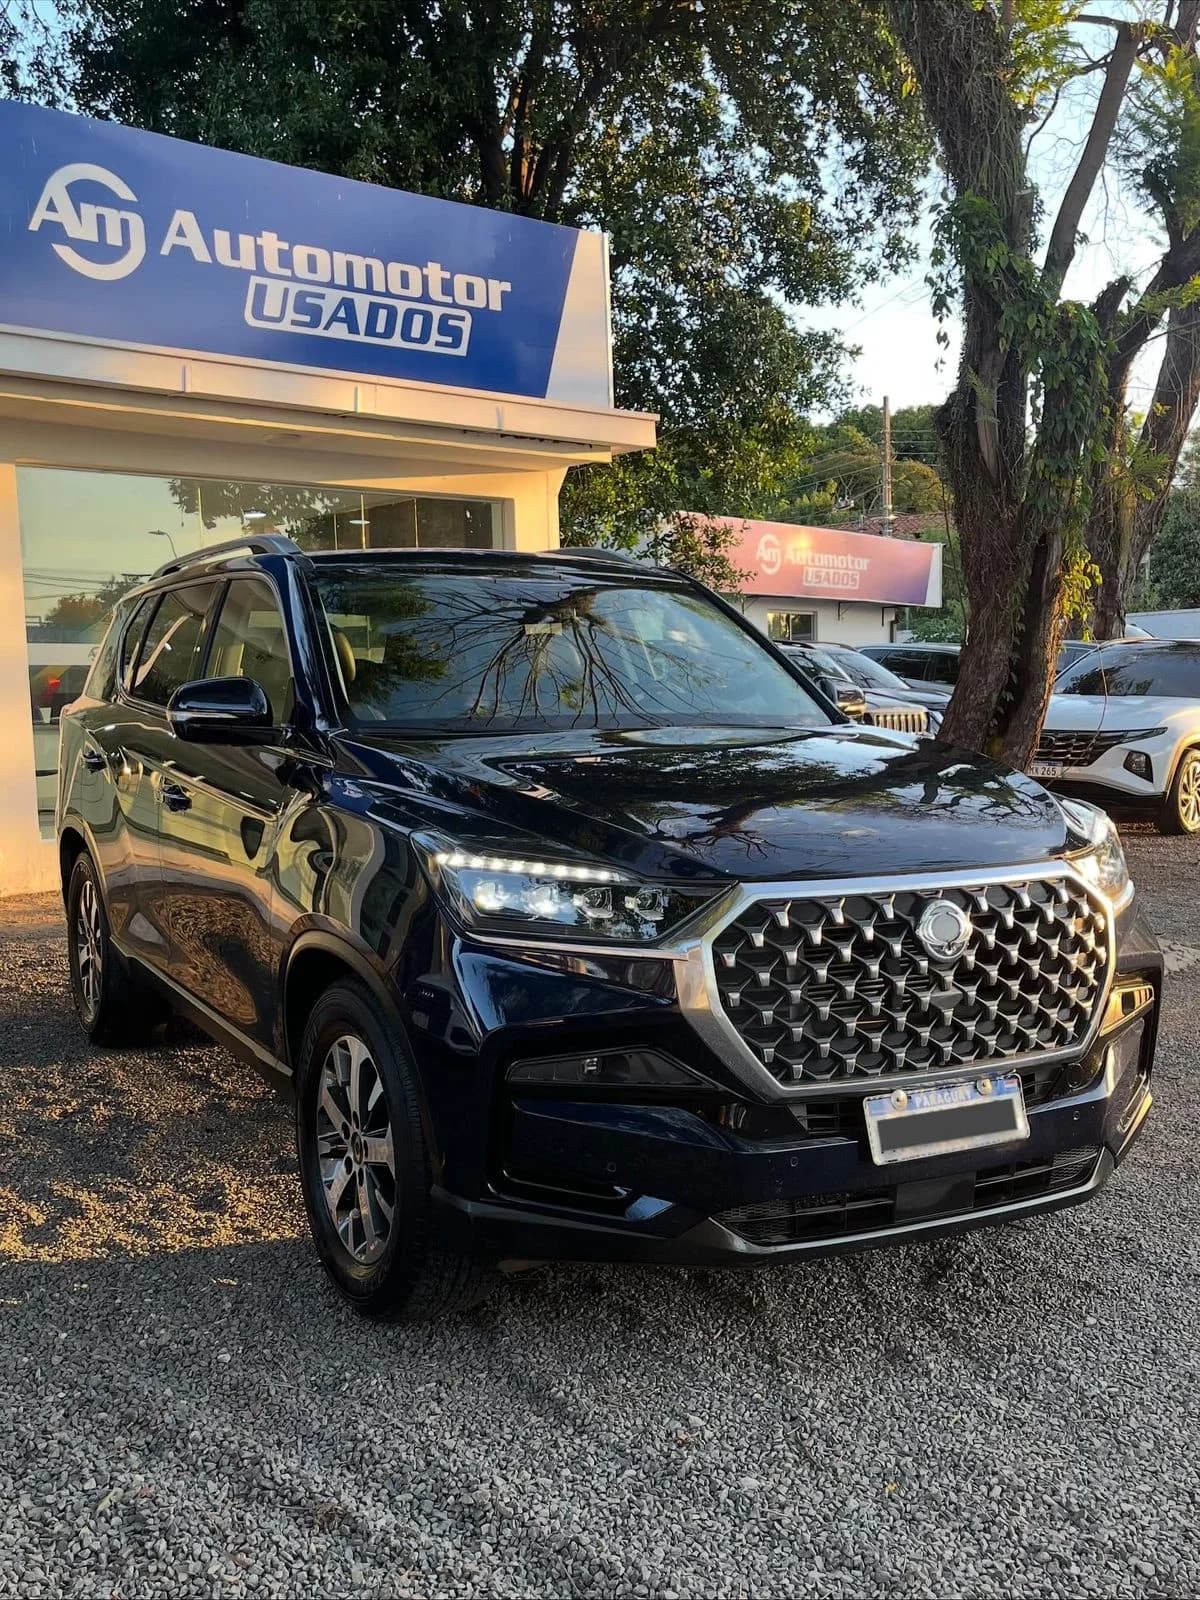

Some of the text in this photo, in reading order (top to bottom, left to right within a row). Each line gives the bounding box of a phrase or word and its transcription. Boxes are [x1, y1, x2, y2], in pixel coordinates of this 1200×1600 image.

[160, 208, 512, 312] Automotor
[249, 282, 467, 350] USADOS
[784, 542, 871, 571] Automotor
[804, 568, 859, 588] USADOS
[1041, 766, 1057, 776] 265
[914, 1087, 973, 1109] PARAGUAY
